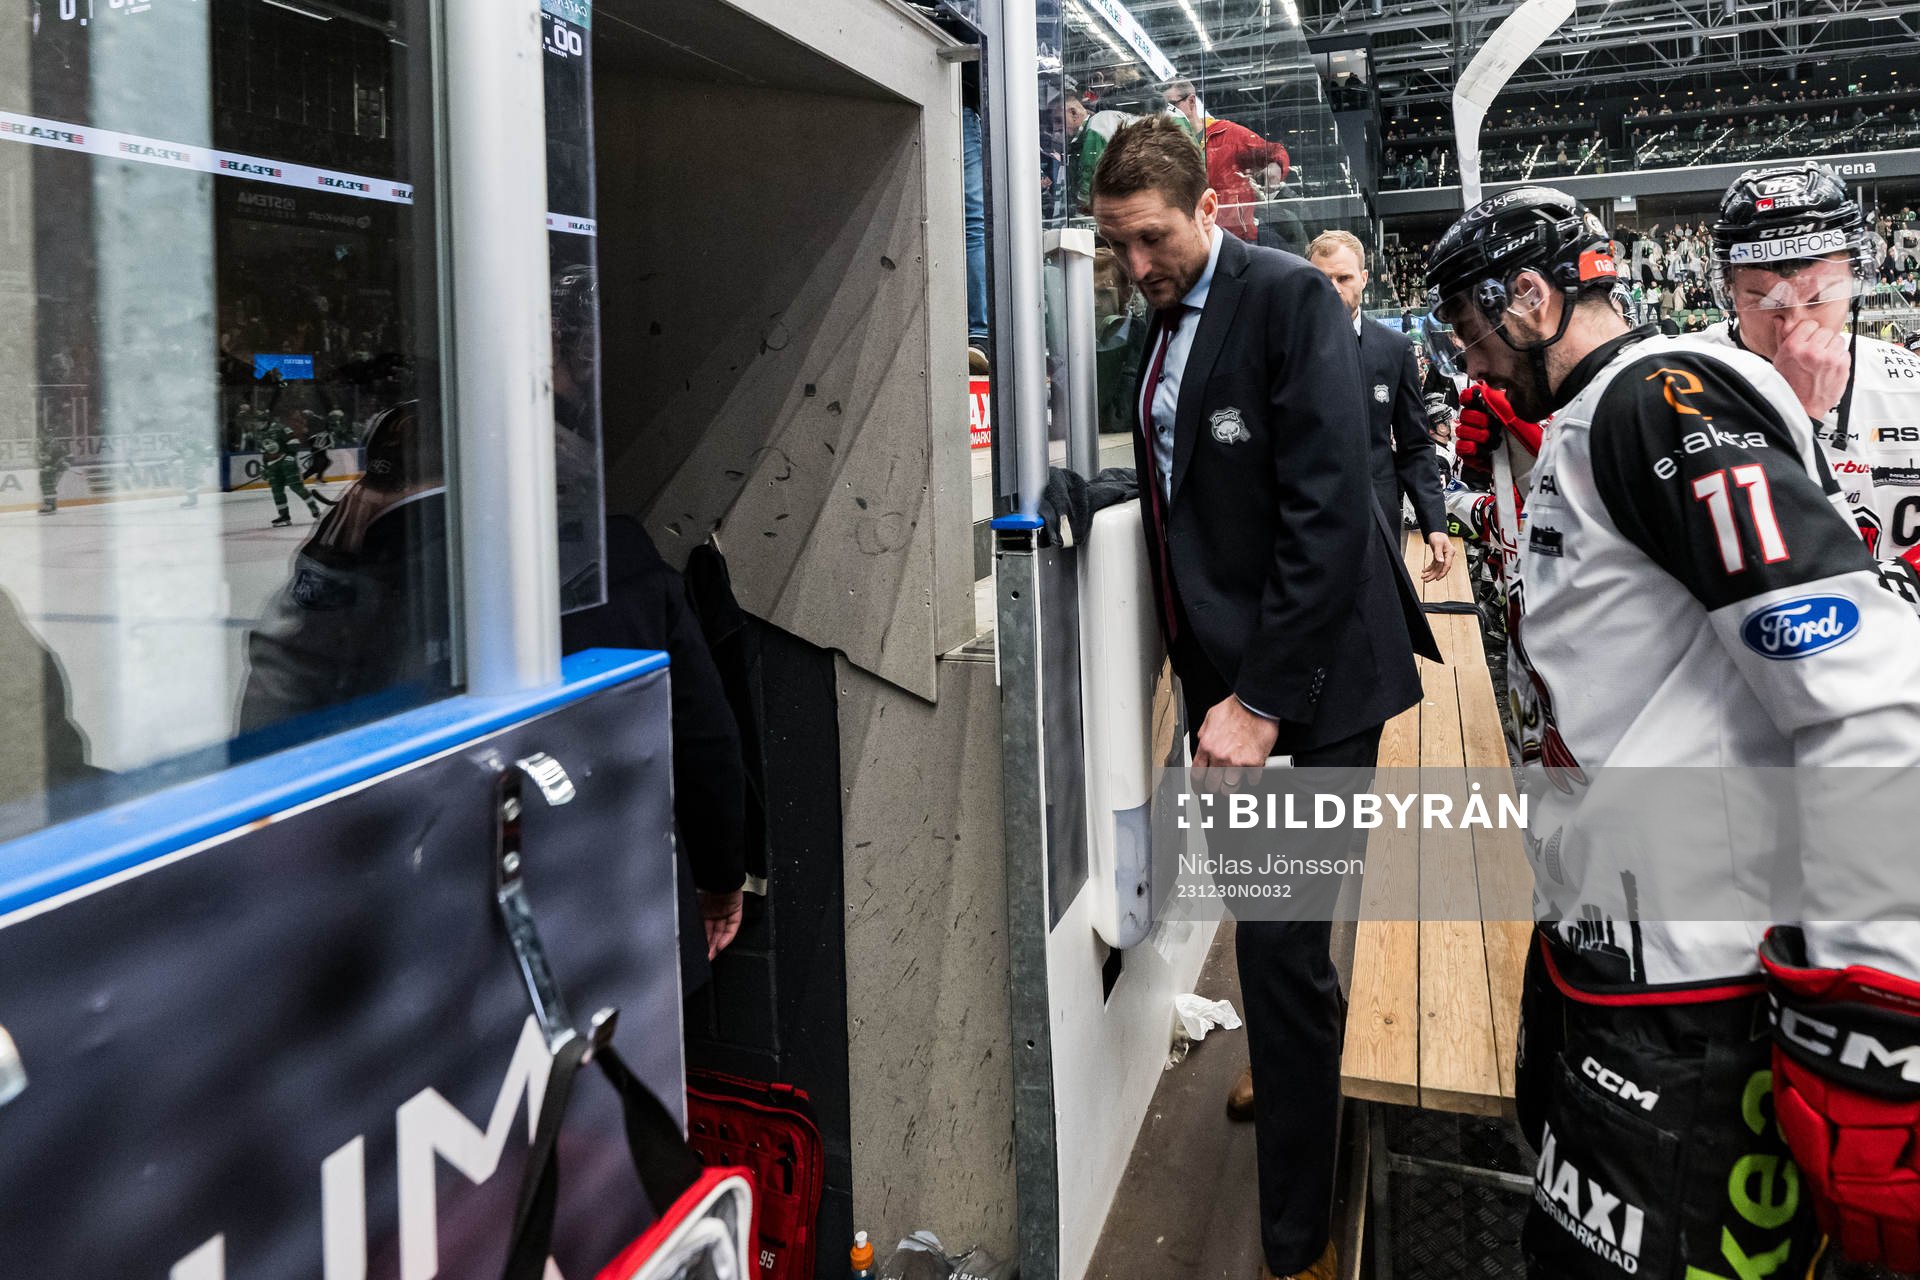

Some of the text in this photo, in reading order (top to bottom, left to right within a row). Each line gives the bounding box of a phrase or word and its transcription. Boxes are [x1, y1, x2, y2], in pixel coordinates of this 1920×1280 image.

[1493, 231, 1535, 259] CCM
[1751, 230, 1845, 260] BJURFORS
[1759, 223, 1815, 239] CCM
[1884, 356, 1920, 367] ARE
[1653, 423, 1769, 480] eakta
[1832, 460, 1870, 474] rbus
[1691, 463, 1790, 575] 11
[1761, 604, 1843, 651] Ford
[1767, 991, 1920, 1083] CM
[1582, 1056, 1660, 1111] CCM
[1536, 1120, 1644, 1258] MAXI
[759, 1250, 776, 1269] 95
